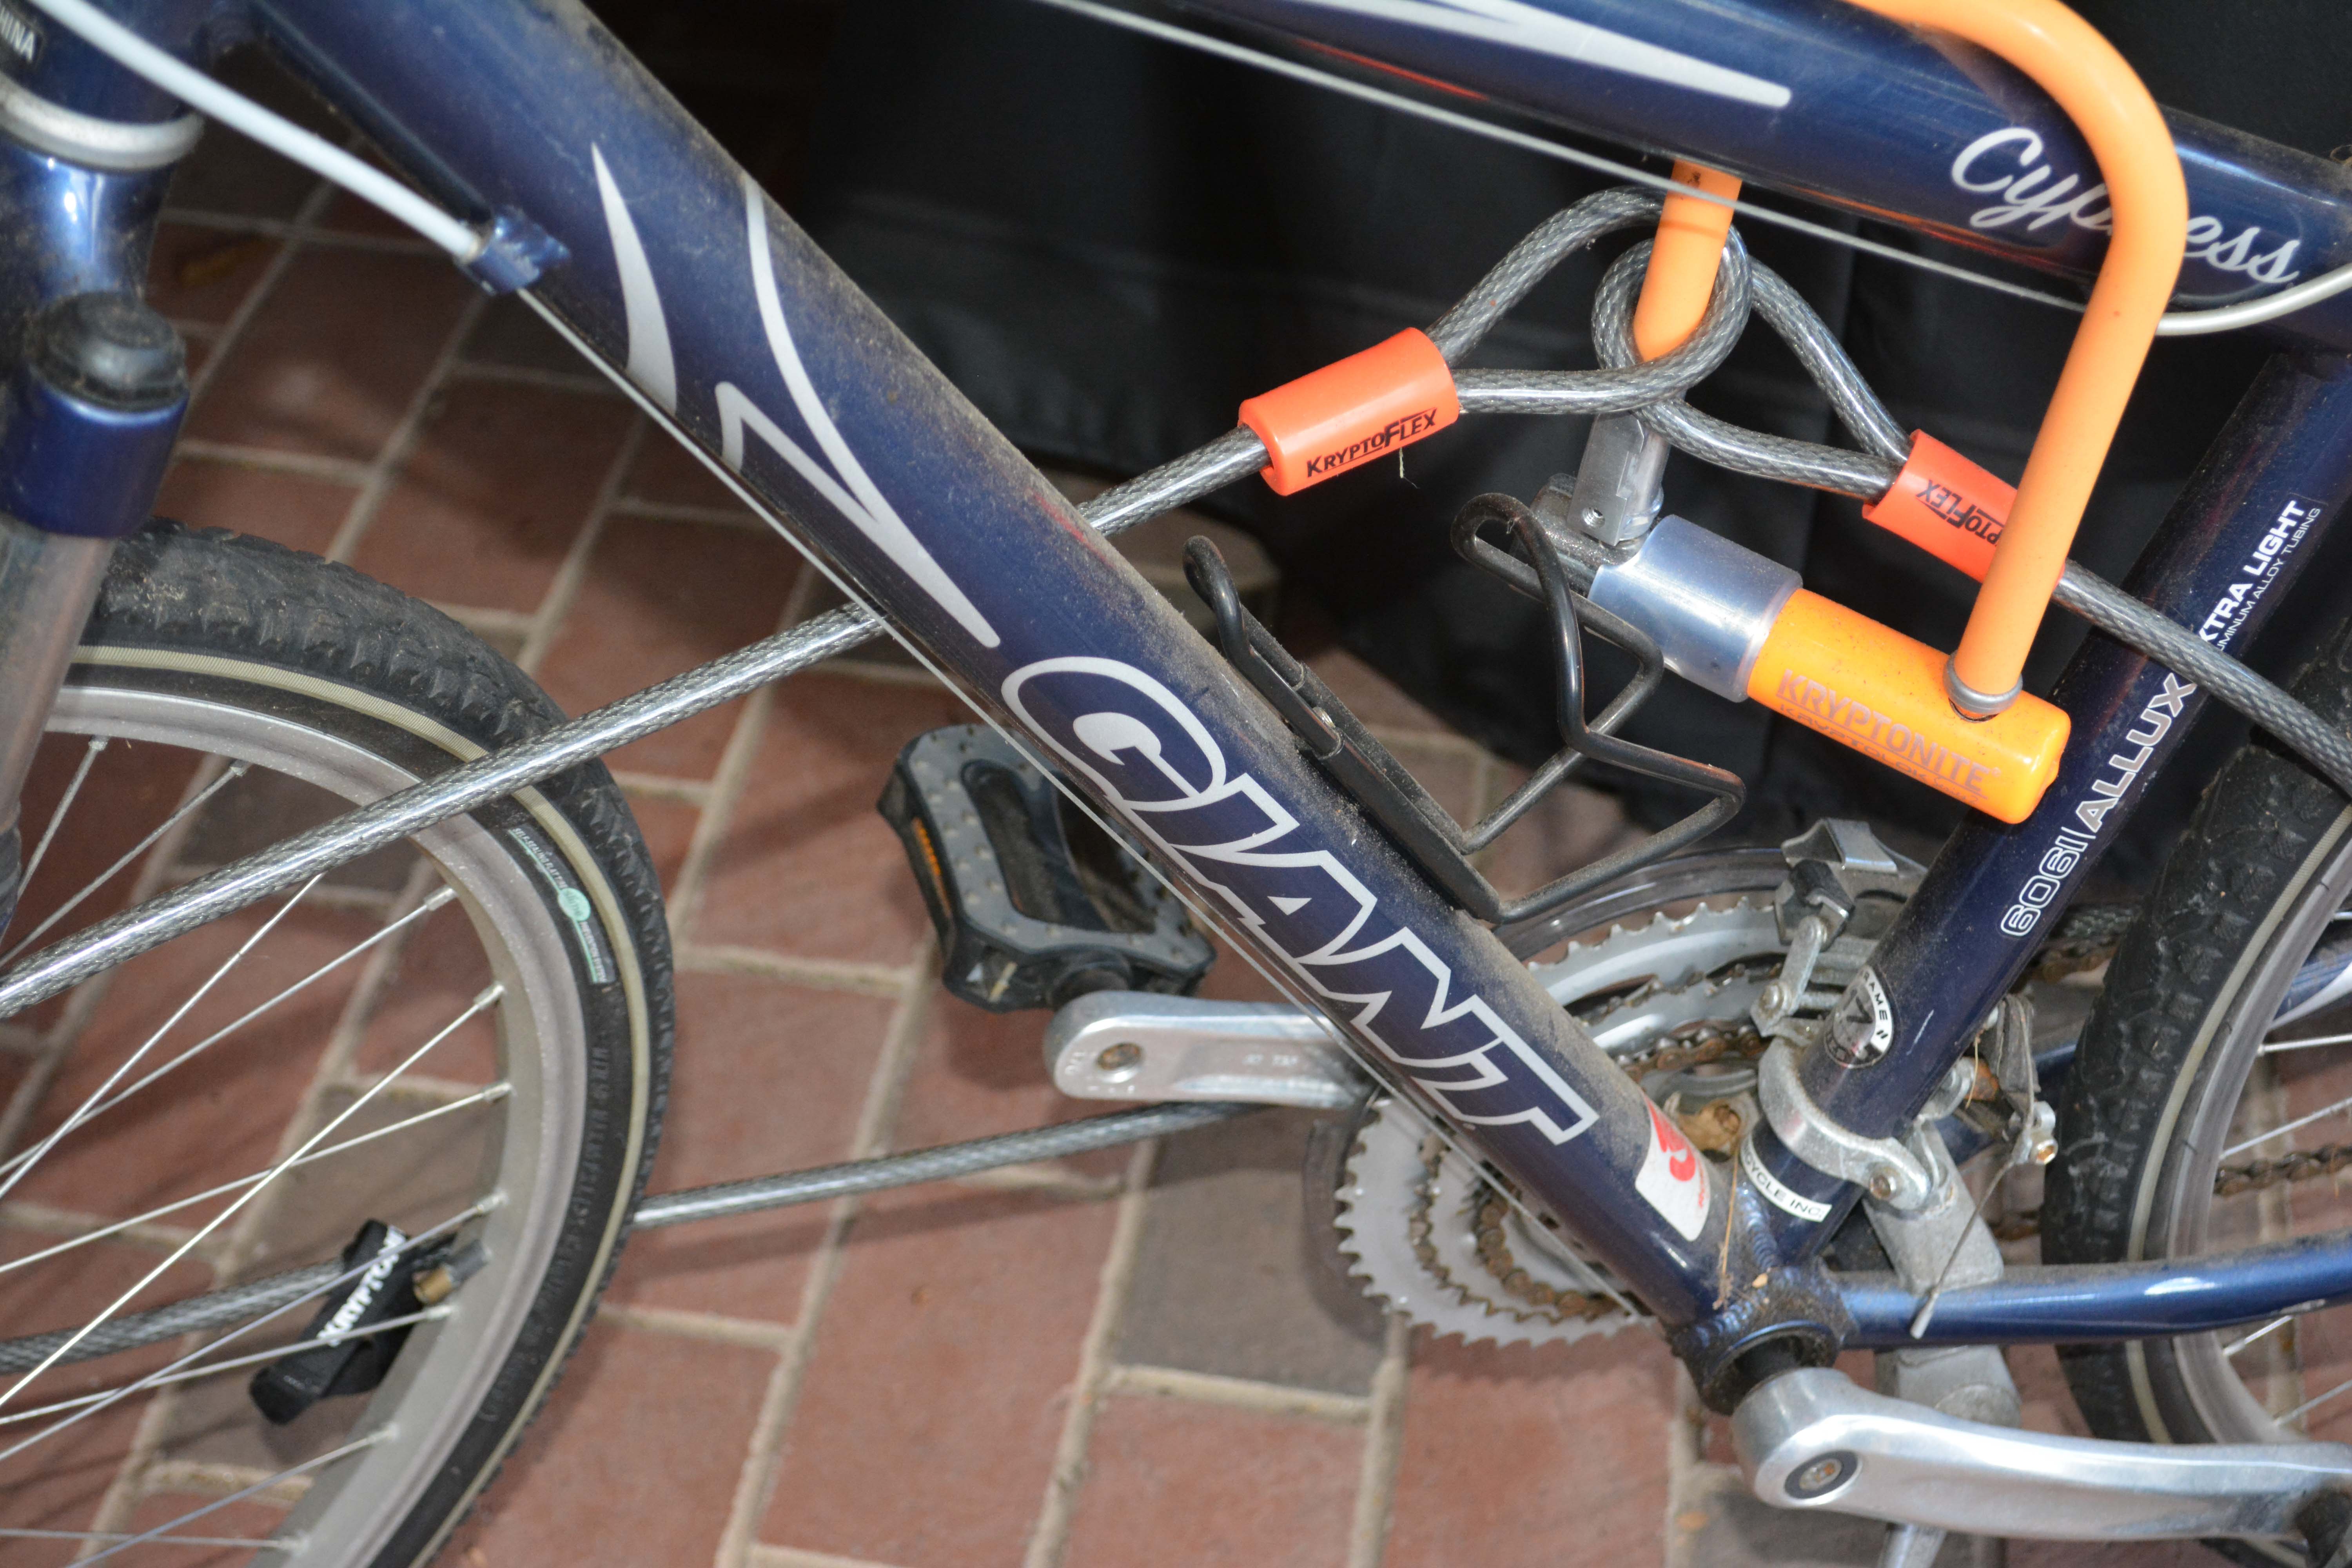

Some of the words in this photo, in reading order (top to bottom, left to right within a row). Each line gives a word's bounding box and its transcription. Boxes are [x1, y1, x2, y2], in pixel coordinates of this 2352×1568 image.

[1951, 127, 2300, 284] Cypess
[1307, 407, 1437, 477] KRYPTOFLEX
[1916, 479, 2004, 547] PTOFLEX
[2243, 500, 2305, 576] LIGHT
[2216, 601, 2256, 652] UMINUM
[2255, 558, 2286, 599] ALLOY
[2281, 508, 2321, 555] TUBING
[1777, 668, 1990, 792] KRYPTONITE
[1780, 704, 1936, 782] KRYPTOLOK
[2000, 835, 2088, 936] 6061
[2076, 673, 2198, 833] ALLUX
[1002, 656, 1599, 1146] GIANT
